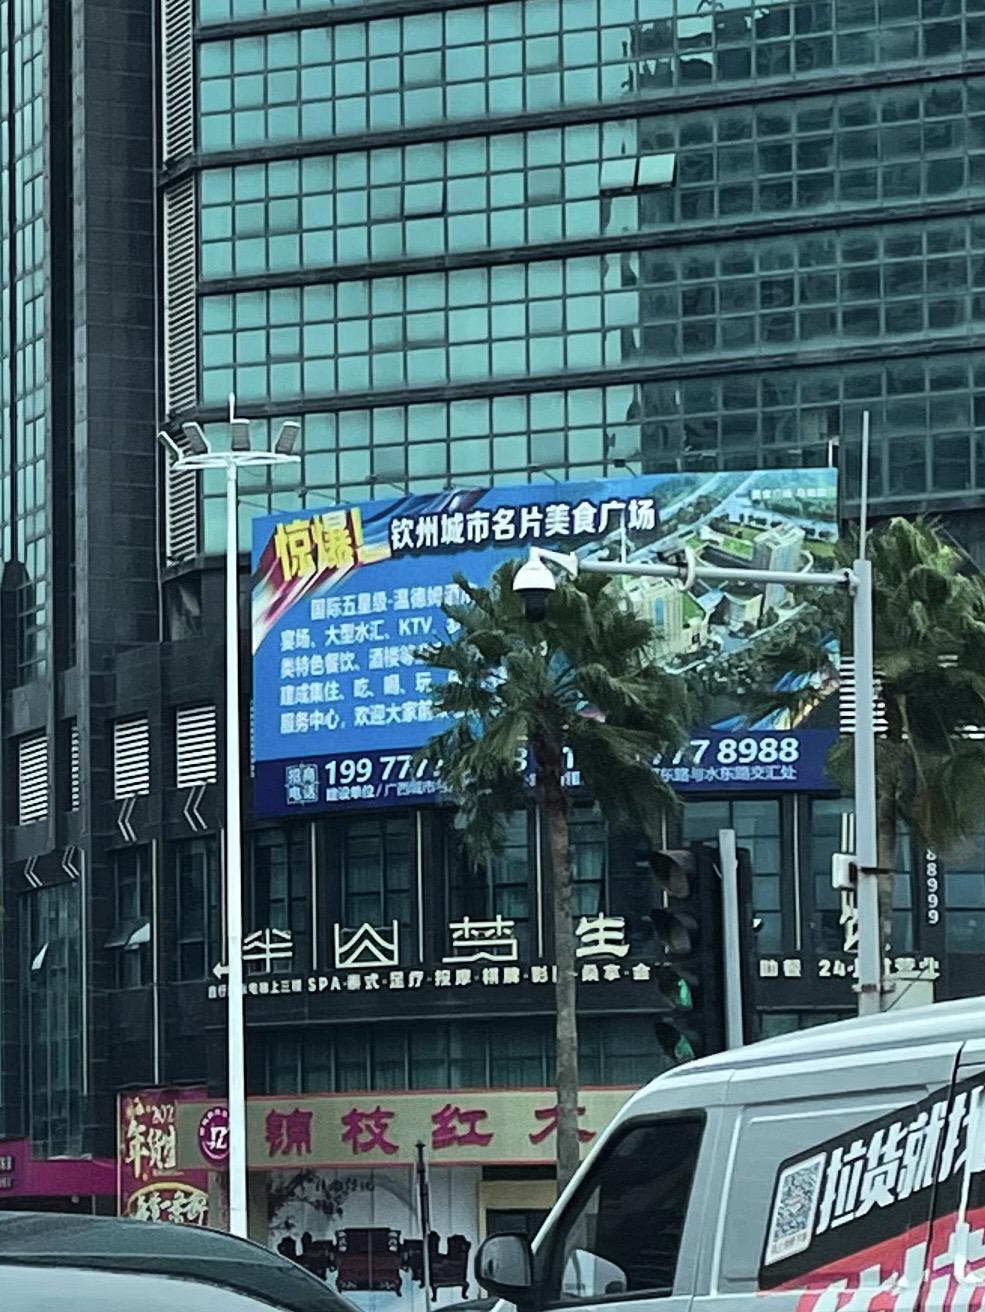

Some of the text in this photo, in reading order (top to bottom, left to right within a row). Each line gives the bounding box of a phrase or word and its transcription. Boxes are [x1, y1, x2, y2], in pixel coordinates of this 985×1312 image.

[390, 498, 657, 550] 钦州城市名片美食广场
[325, 758, 373, 785] 199
[716, 737, 800, 765] 8988
